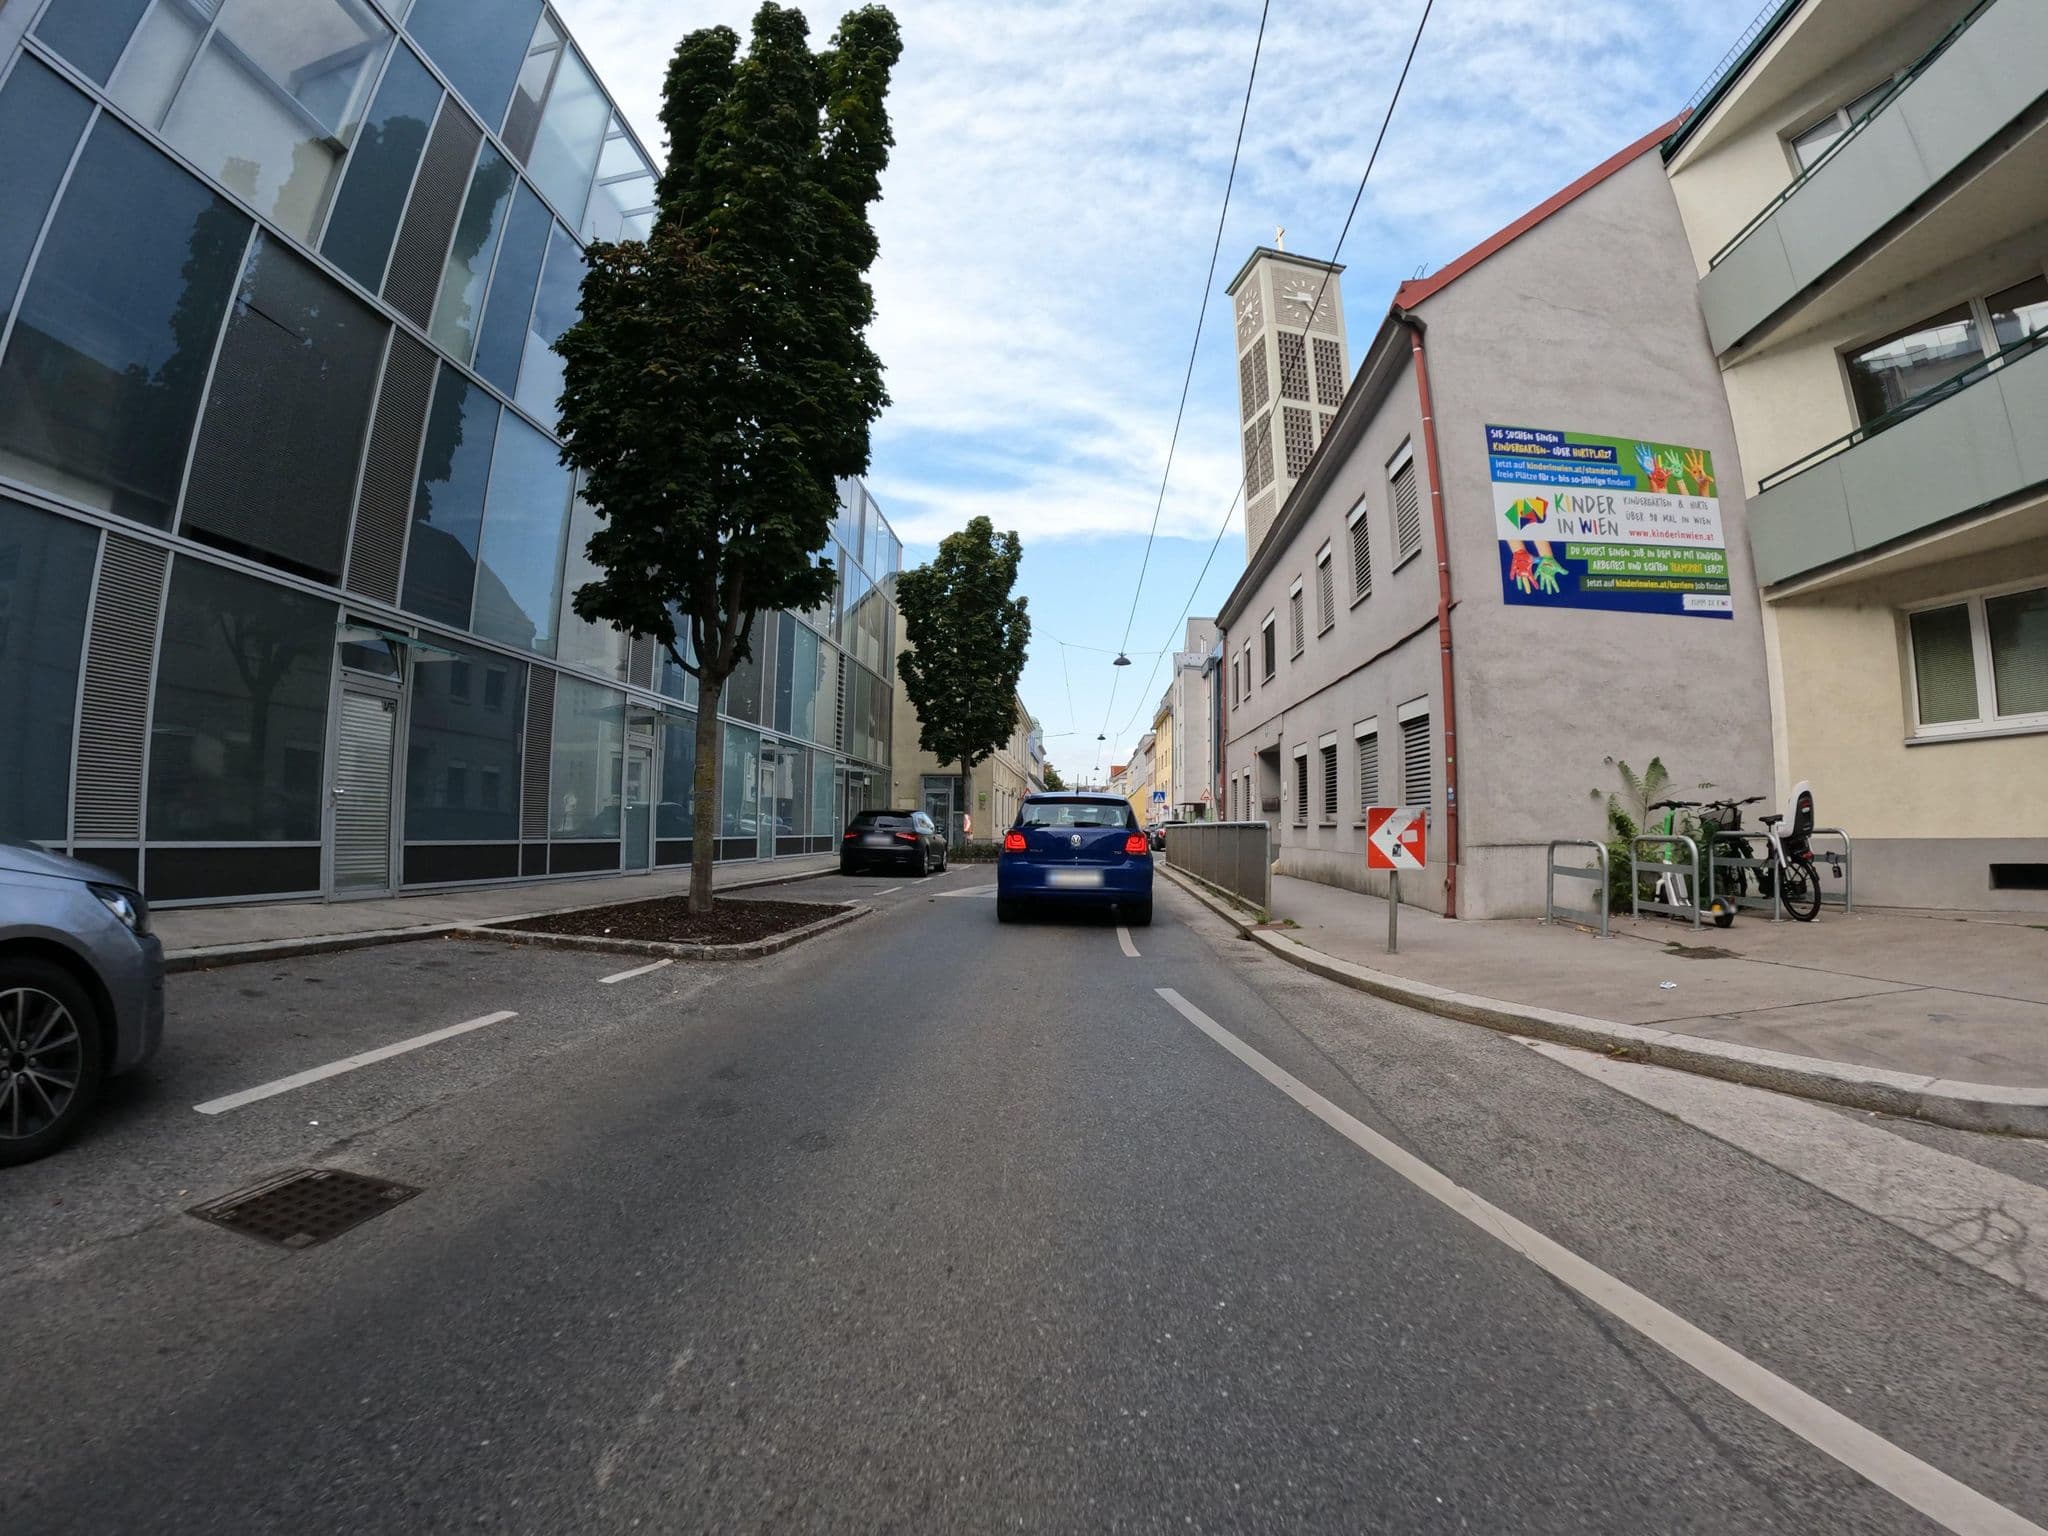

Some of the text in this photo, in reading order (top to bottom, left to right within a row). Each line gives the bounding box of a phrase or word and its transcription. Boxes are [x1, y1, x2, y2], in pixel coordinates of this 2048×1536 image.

[1554, 493, 1616, 515] KINDER
[1558, 517, 1619, 536] IN WIEN
[1694, 515, 1712, 525] WIEN
[1629, 528, 1714, 541] www.kinderinwien.at
